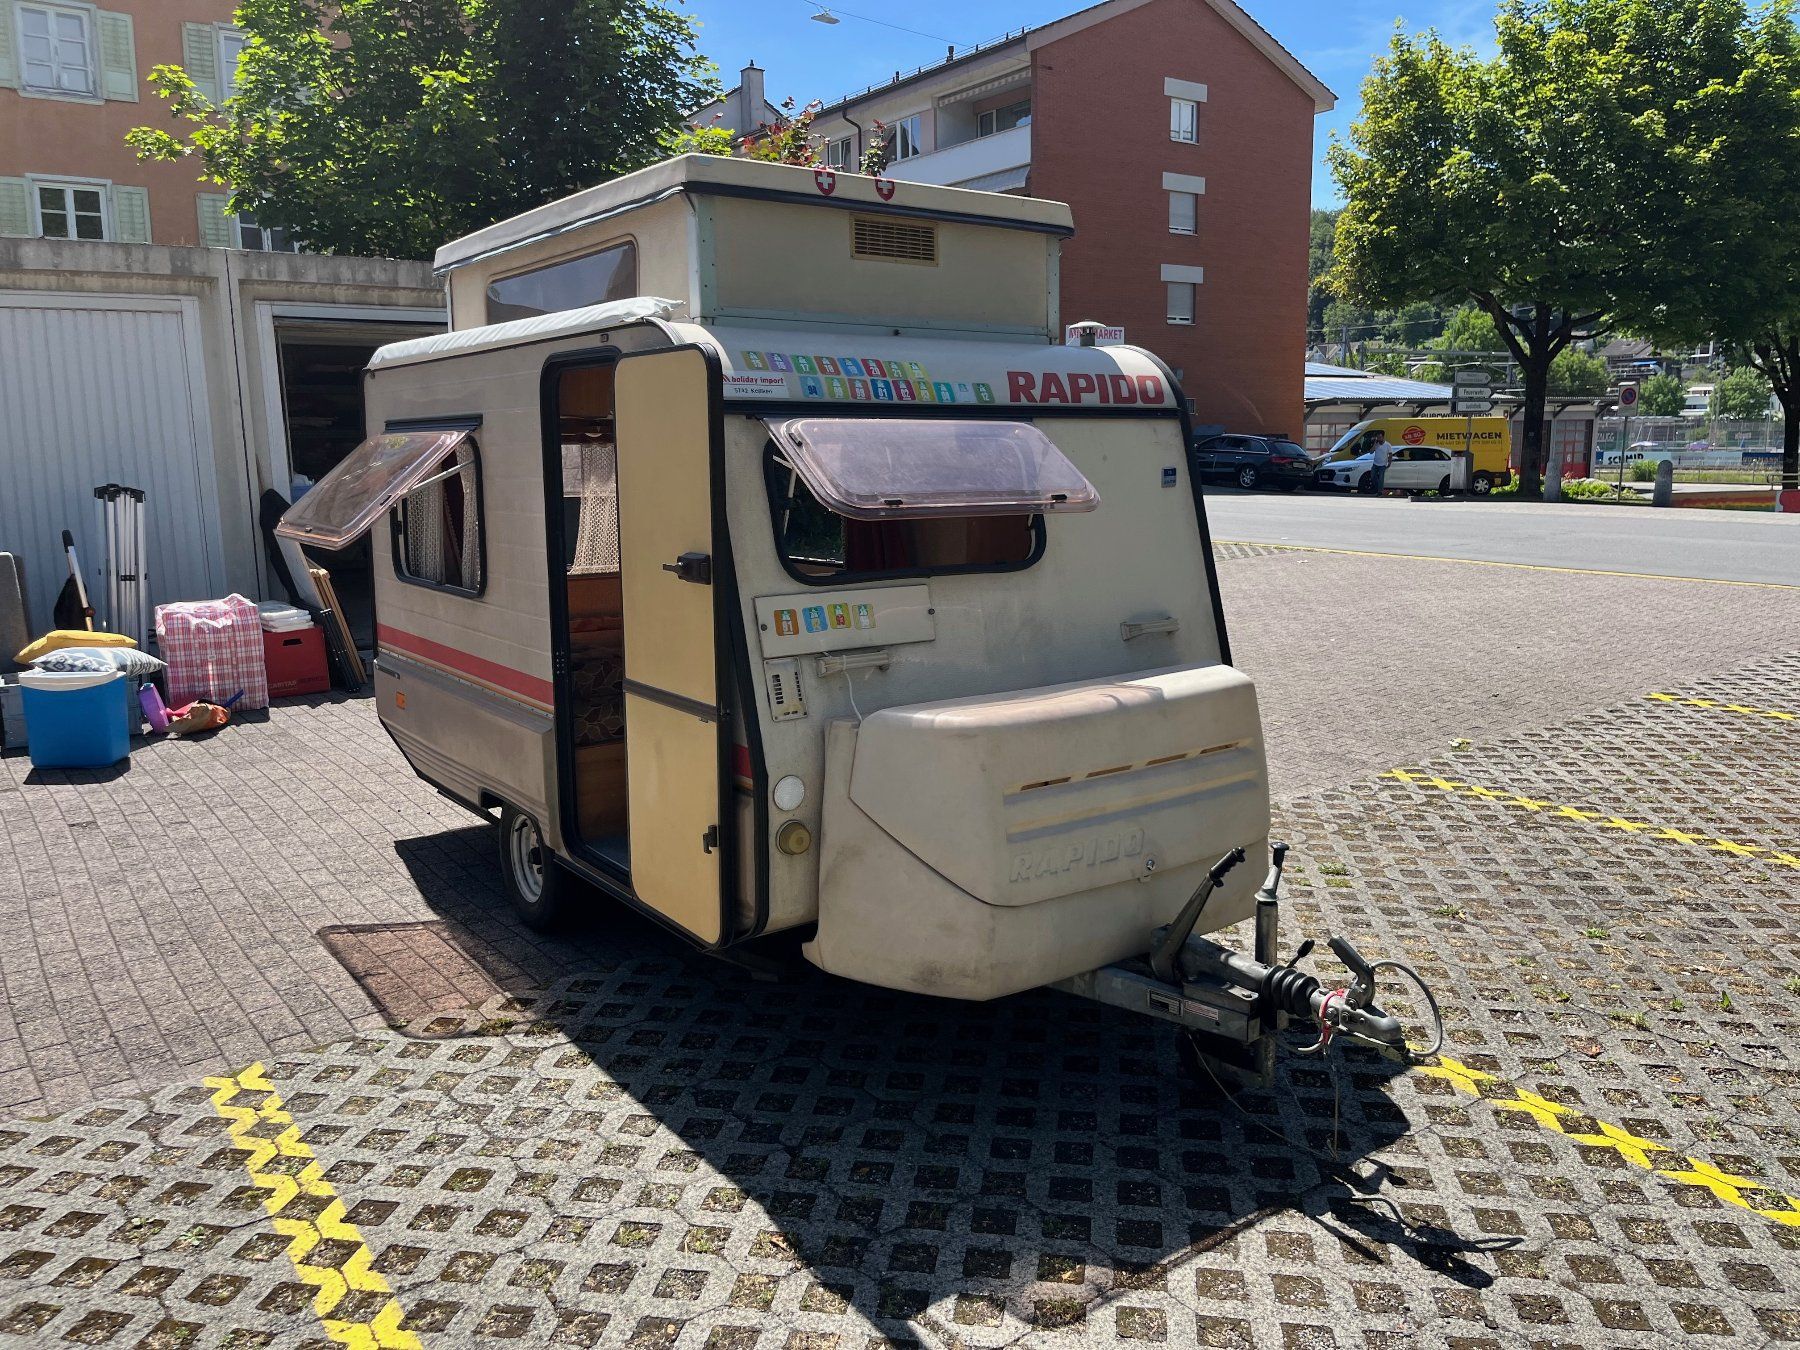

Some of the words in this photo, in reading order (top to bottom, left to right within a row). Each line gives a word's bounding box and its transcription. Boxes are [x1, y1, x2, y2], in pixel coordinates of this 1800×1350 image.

[731, 375, 758, 384] holiday
[1007, 371, 1165, 404] RAPIDO
[1436, 431, 1502, 441] MIETWAGEN
[1009, 828, 1145, 883] RAPIDO
